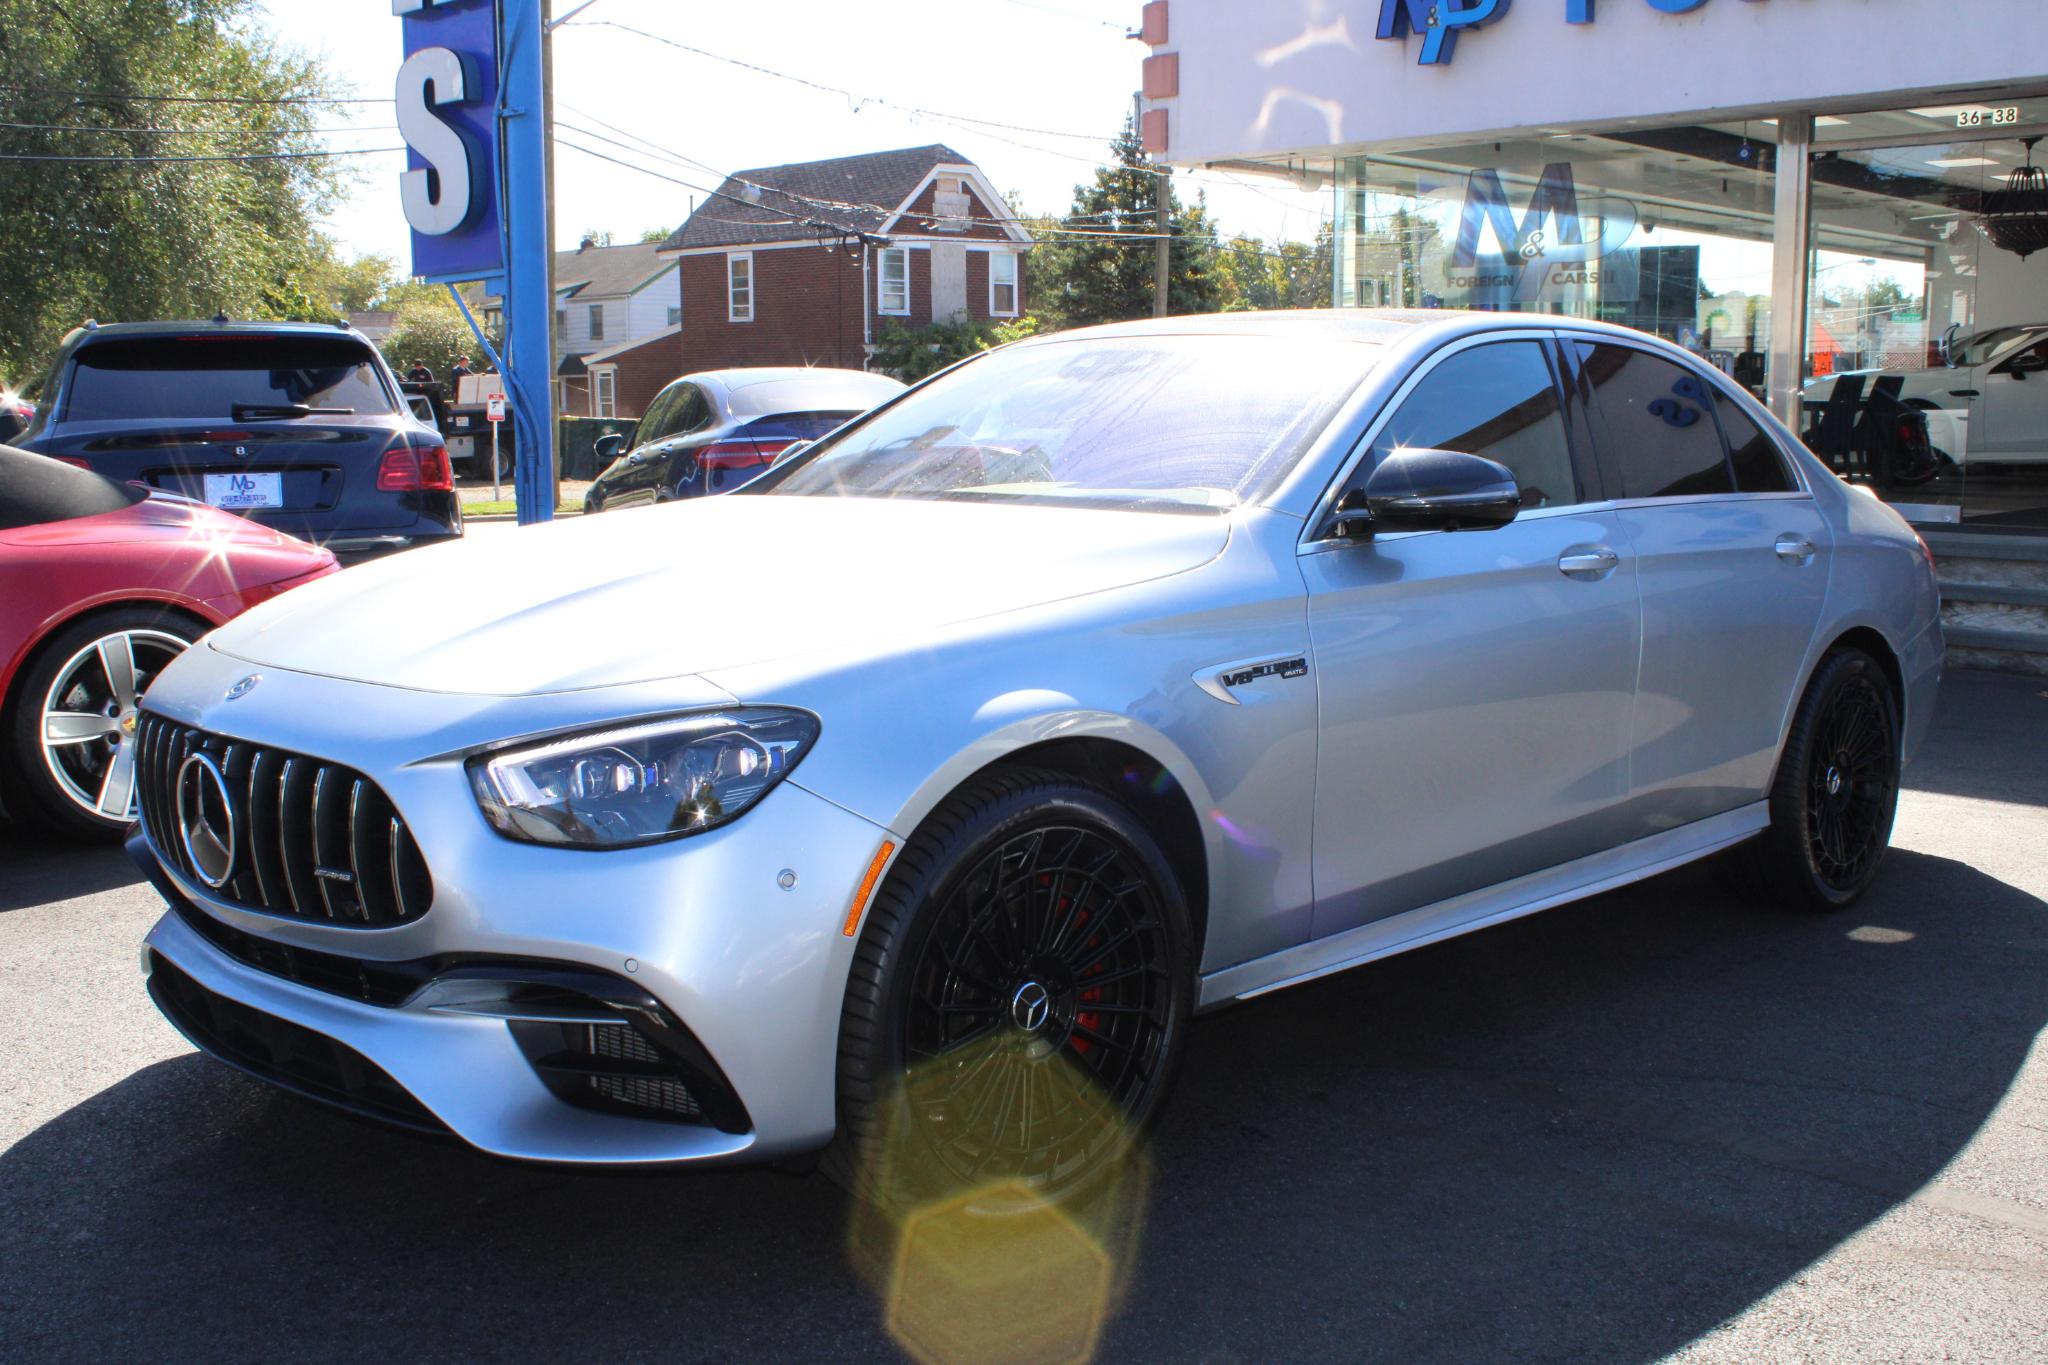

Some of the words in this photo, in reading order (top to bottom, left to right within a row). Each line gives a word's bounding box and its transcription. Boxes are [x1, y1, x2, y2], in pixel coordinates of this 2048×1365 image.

[390, 0, 480, 236] S
[1959, 108, 2015, 126] 36-38
[1447, 274, 1514, 289] FOREIGN
[1551, 271, 1598, 286] CARS
